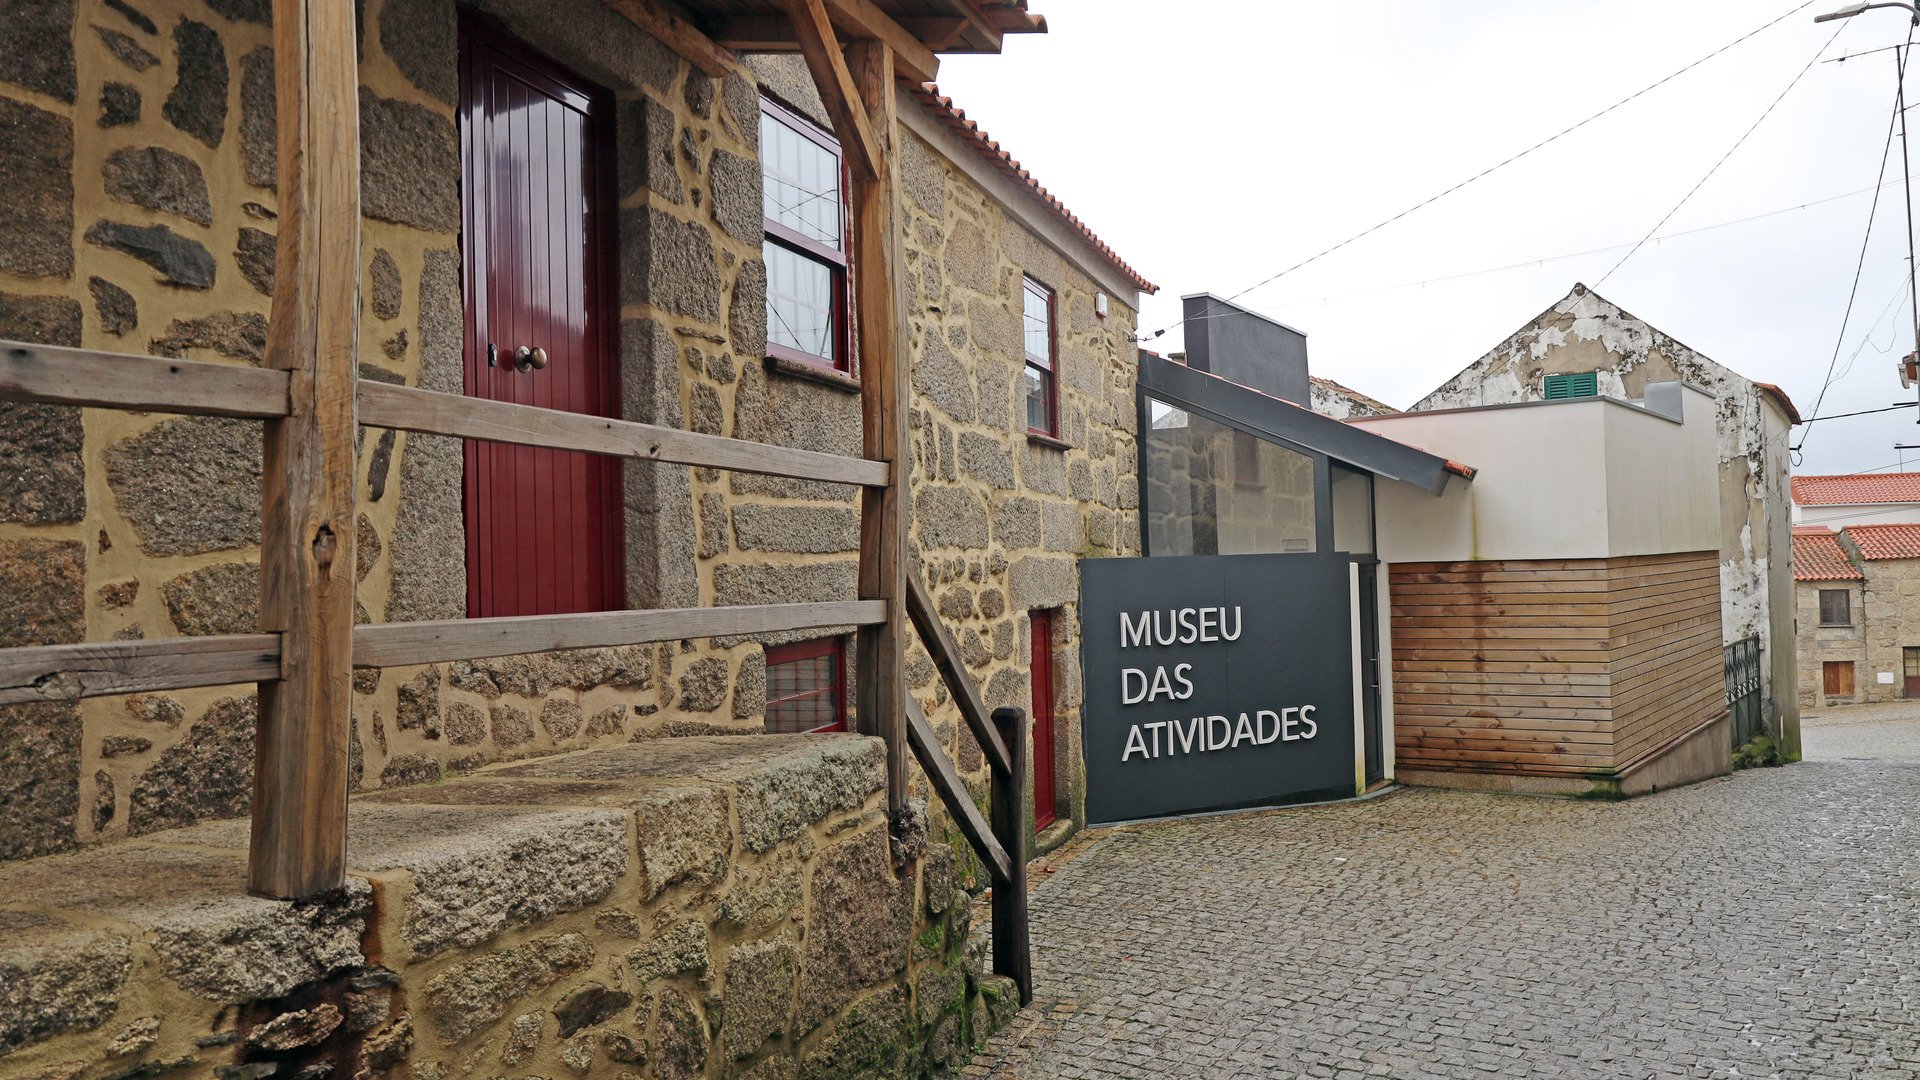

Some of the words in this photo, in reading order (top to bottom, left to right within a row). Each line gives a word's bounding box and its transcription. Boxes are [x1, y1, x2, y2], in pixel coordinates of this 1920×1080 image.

[1119, 605, 1242, 648] MUSEU
[1121, 662, 1194, 705] DAS
[1121, 704, 1318, 762] ATIVIDADES
